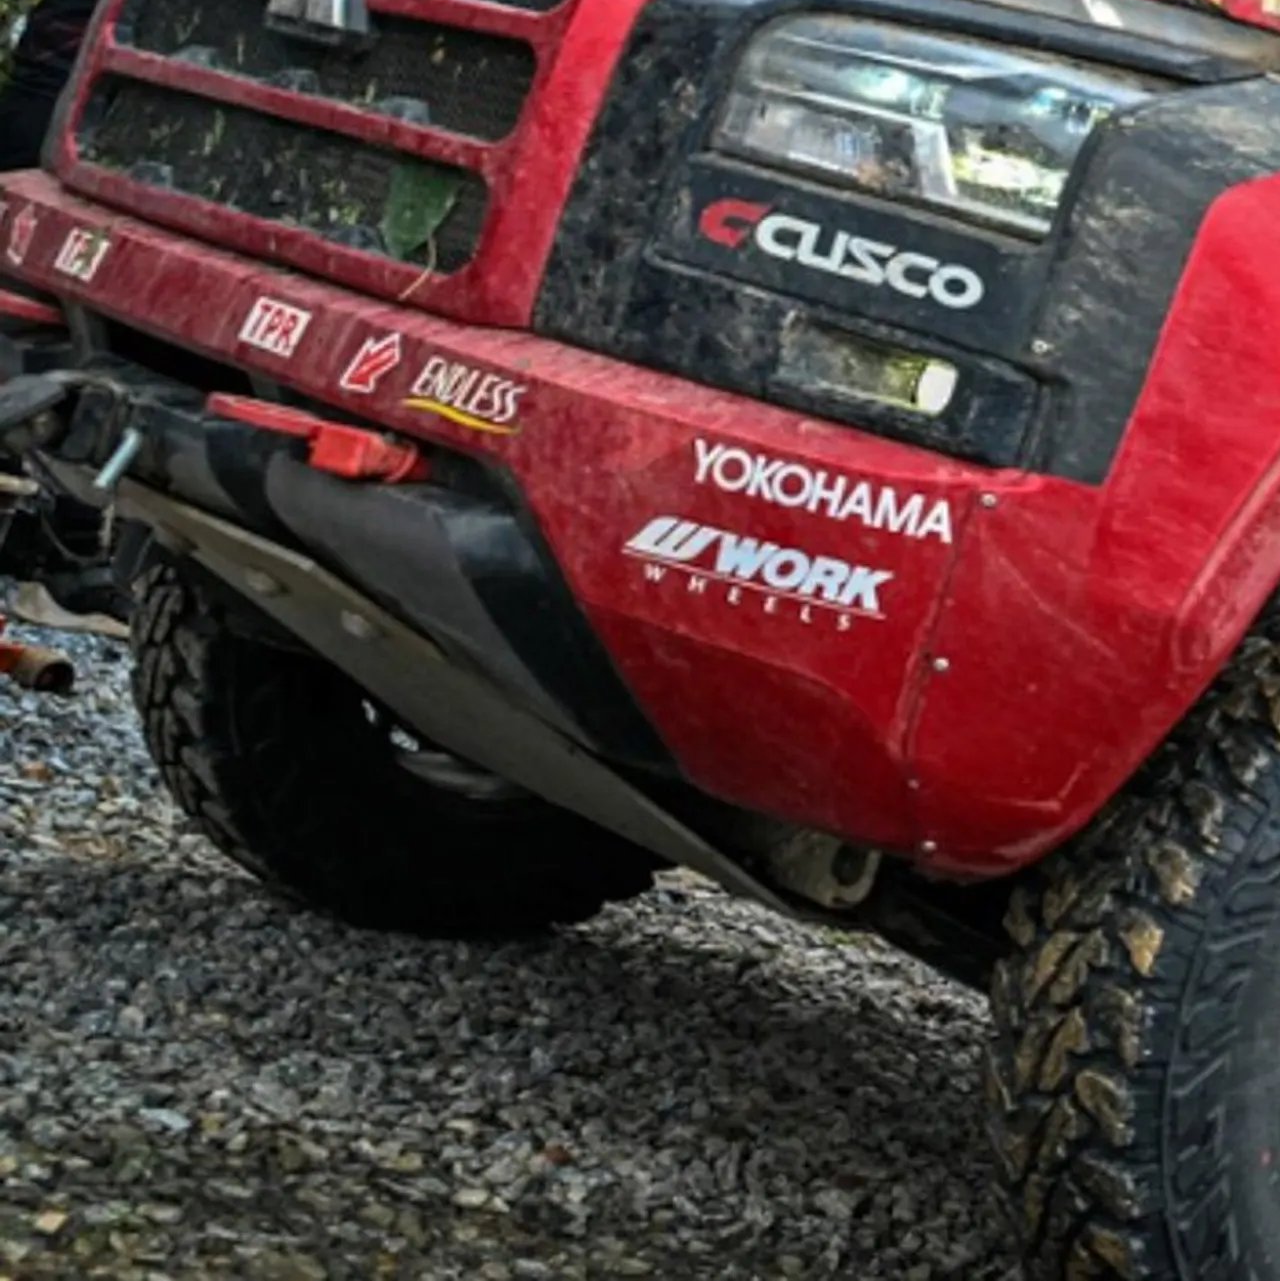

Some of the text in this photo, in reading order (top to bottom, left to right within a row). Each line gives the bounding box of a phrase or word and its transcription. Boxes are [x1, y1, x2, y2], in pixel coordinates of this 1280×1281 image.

[756, 213, 984, 309] CUSCO
[409, 354, 528, 423] ENDLESS
[693, 437, 953, 545] YOKOHAMA
[643, 563, 852, 632] WHEELS
[714, 532, 895, 613] WORK
